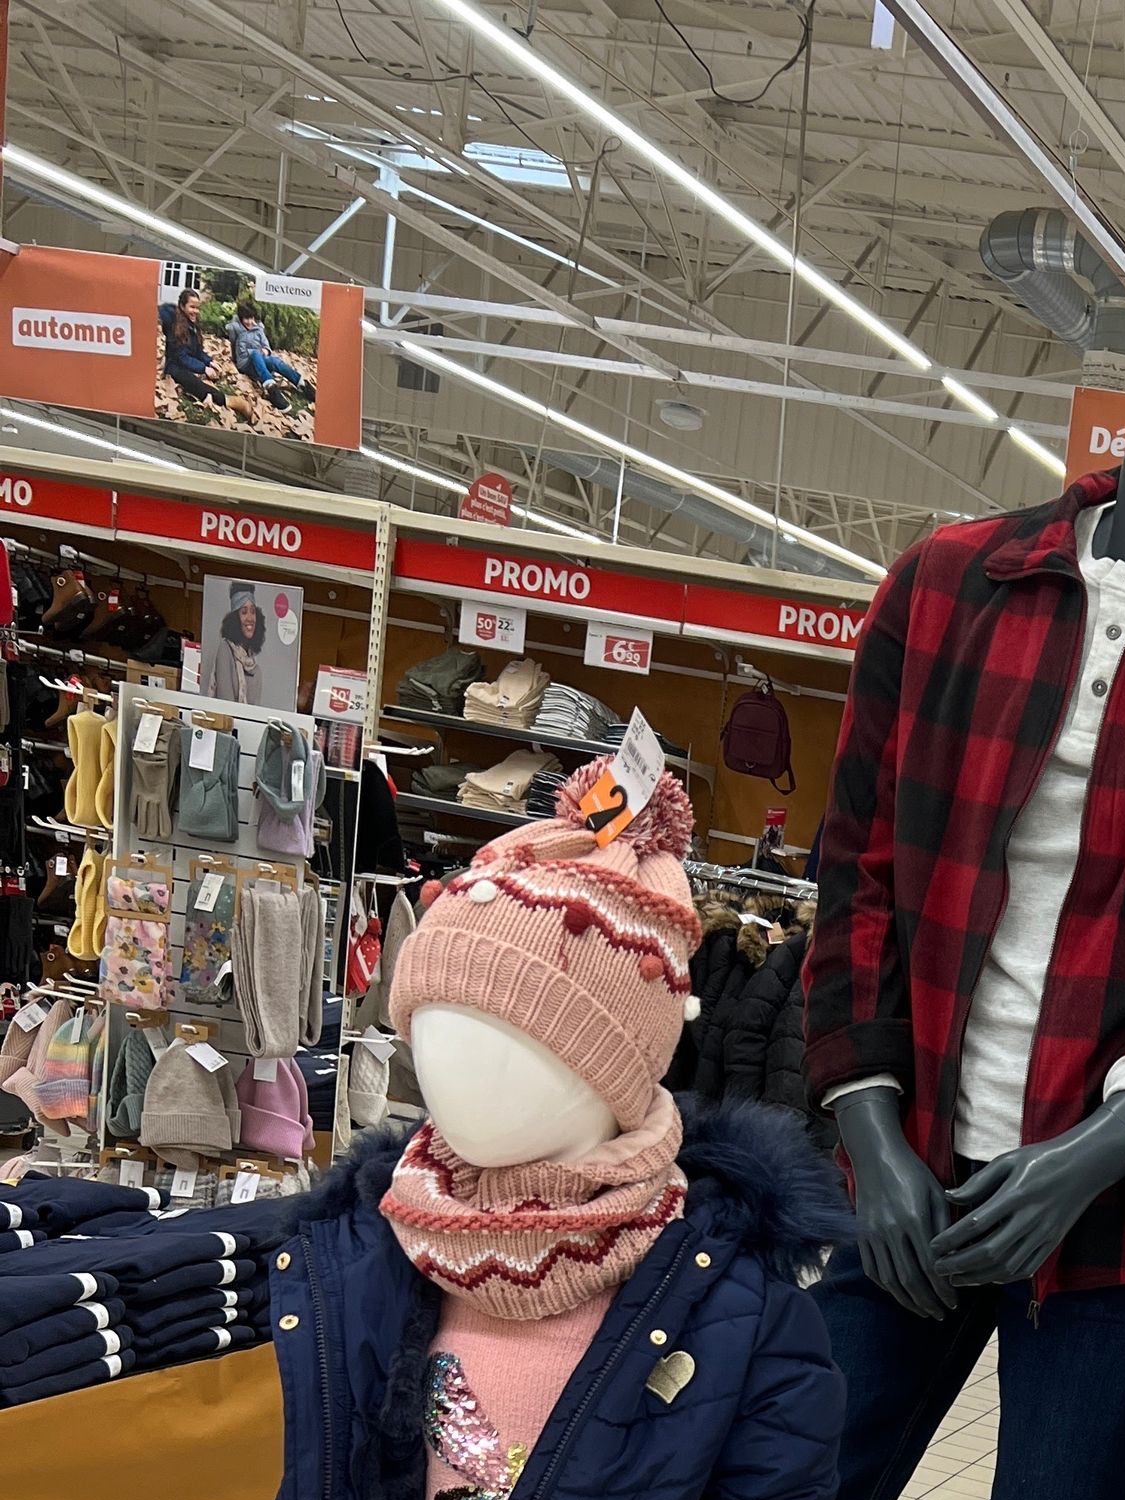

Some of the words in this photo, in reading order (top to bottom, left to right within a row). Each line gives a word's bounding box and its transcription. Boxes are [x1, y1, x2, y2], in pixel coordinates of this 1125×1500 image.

[264, 280, 313, 298] Inextenso
[17, 315, 126, 346] automne
[200, 510, 303, 553] PROMO
[484, 556, 592, 600] PROMO
